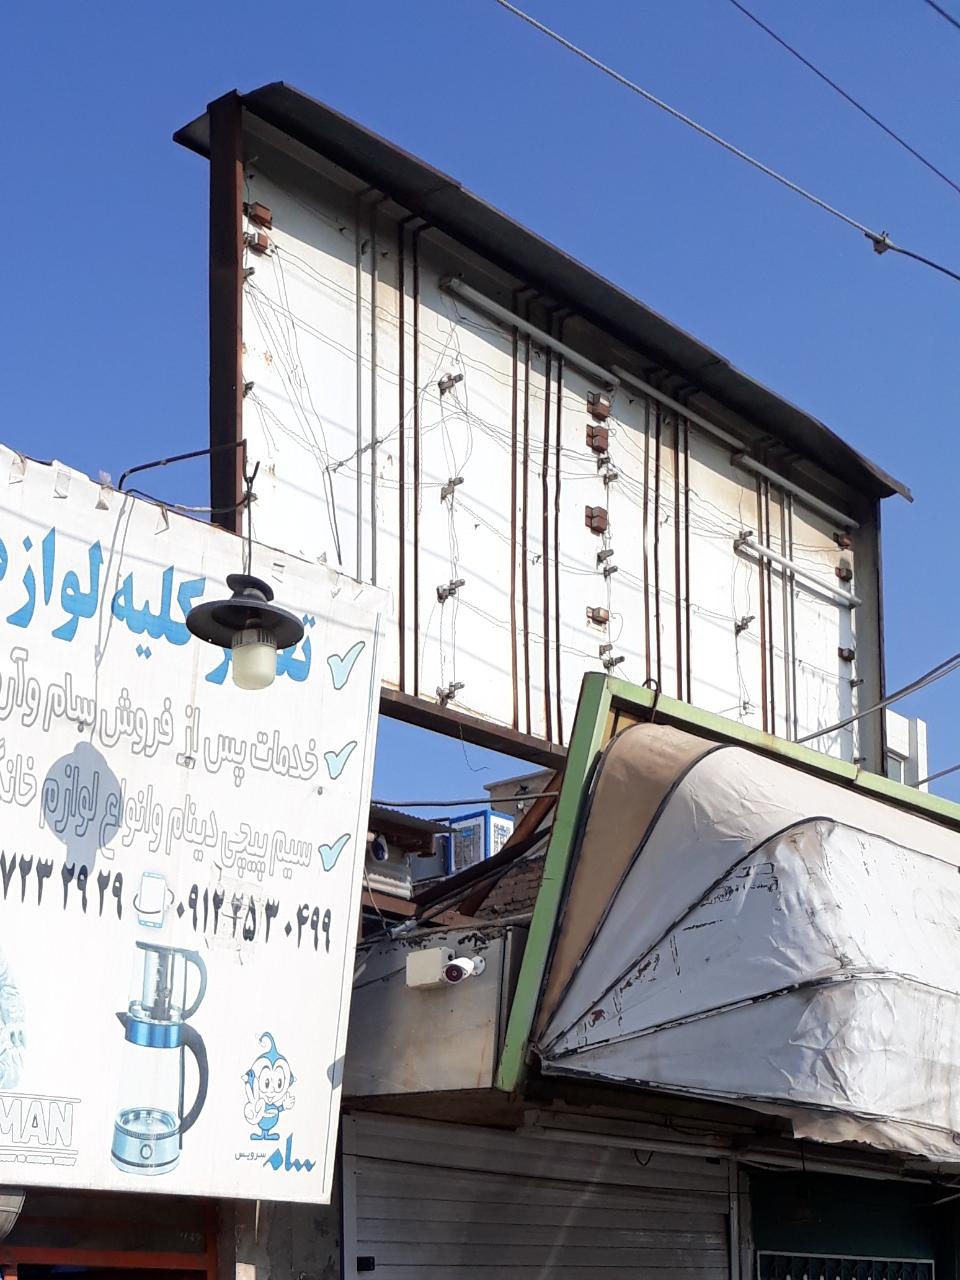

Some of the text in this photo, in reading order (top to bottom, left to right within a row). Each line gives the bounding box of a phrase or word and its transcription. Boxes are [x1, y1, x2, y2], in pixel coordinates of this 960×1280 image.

[42, 672, 97, 732] سام
[99, 687, 174, 758] فروش
[176, 704, 201, 770] از
[204, 734, 246, 788] پس
[250, 730, 319, 780] خدمات
[39, 752, 100, 838] لوازم
[165, 794, 219, 862] دینام
[269, 830, 313, 880] سیم
[235, 1152, 267, 1161] سرویس
